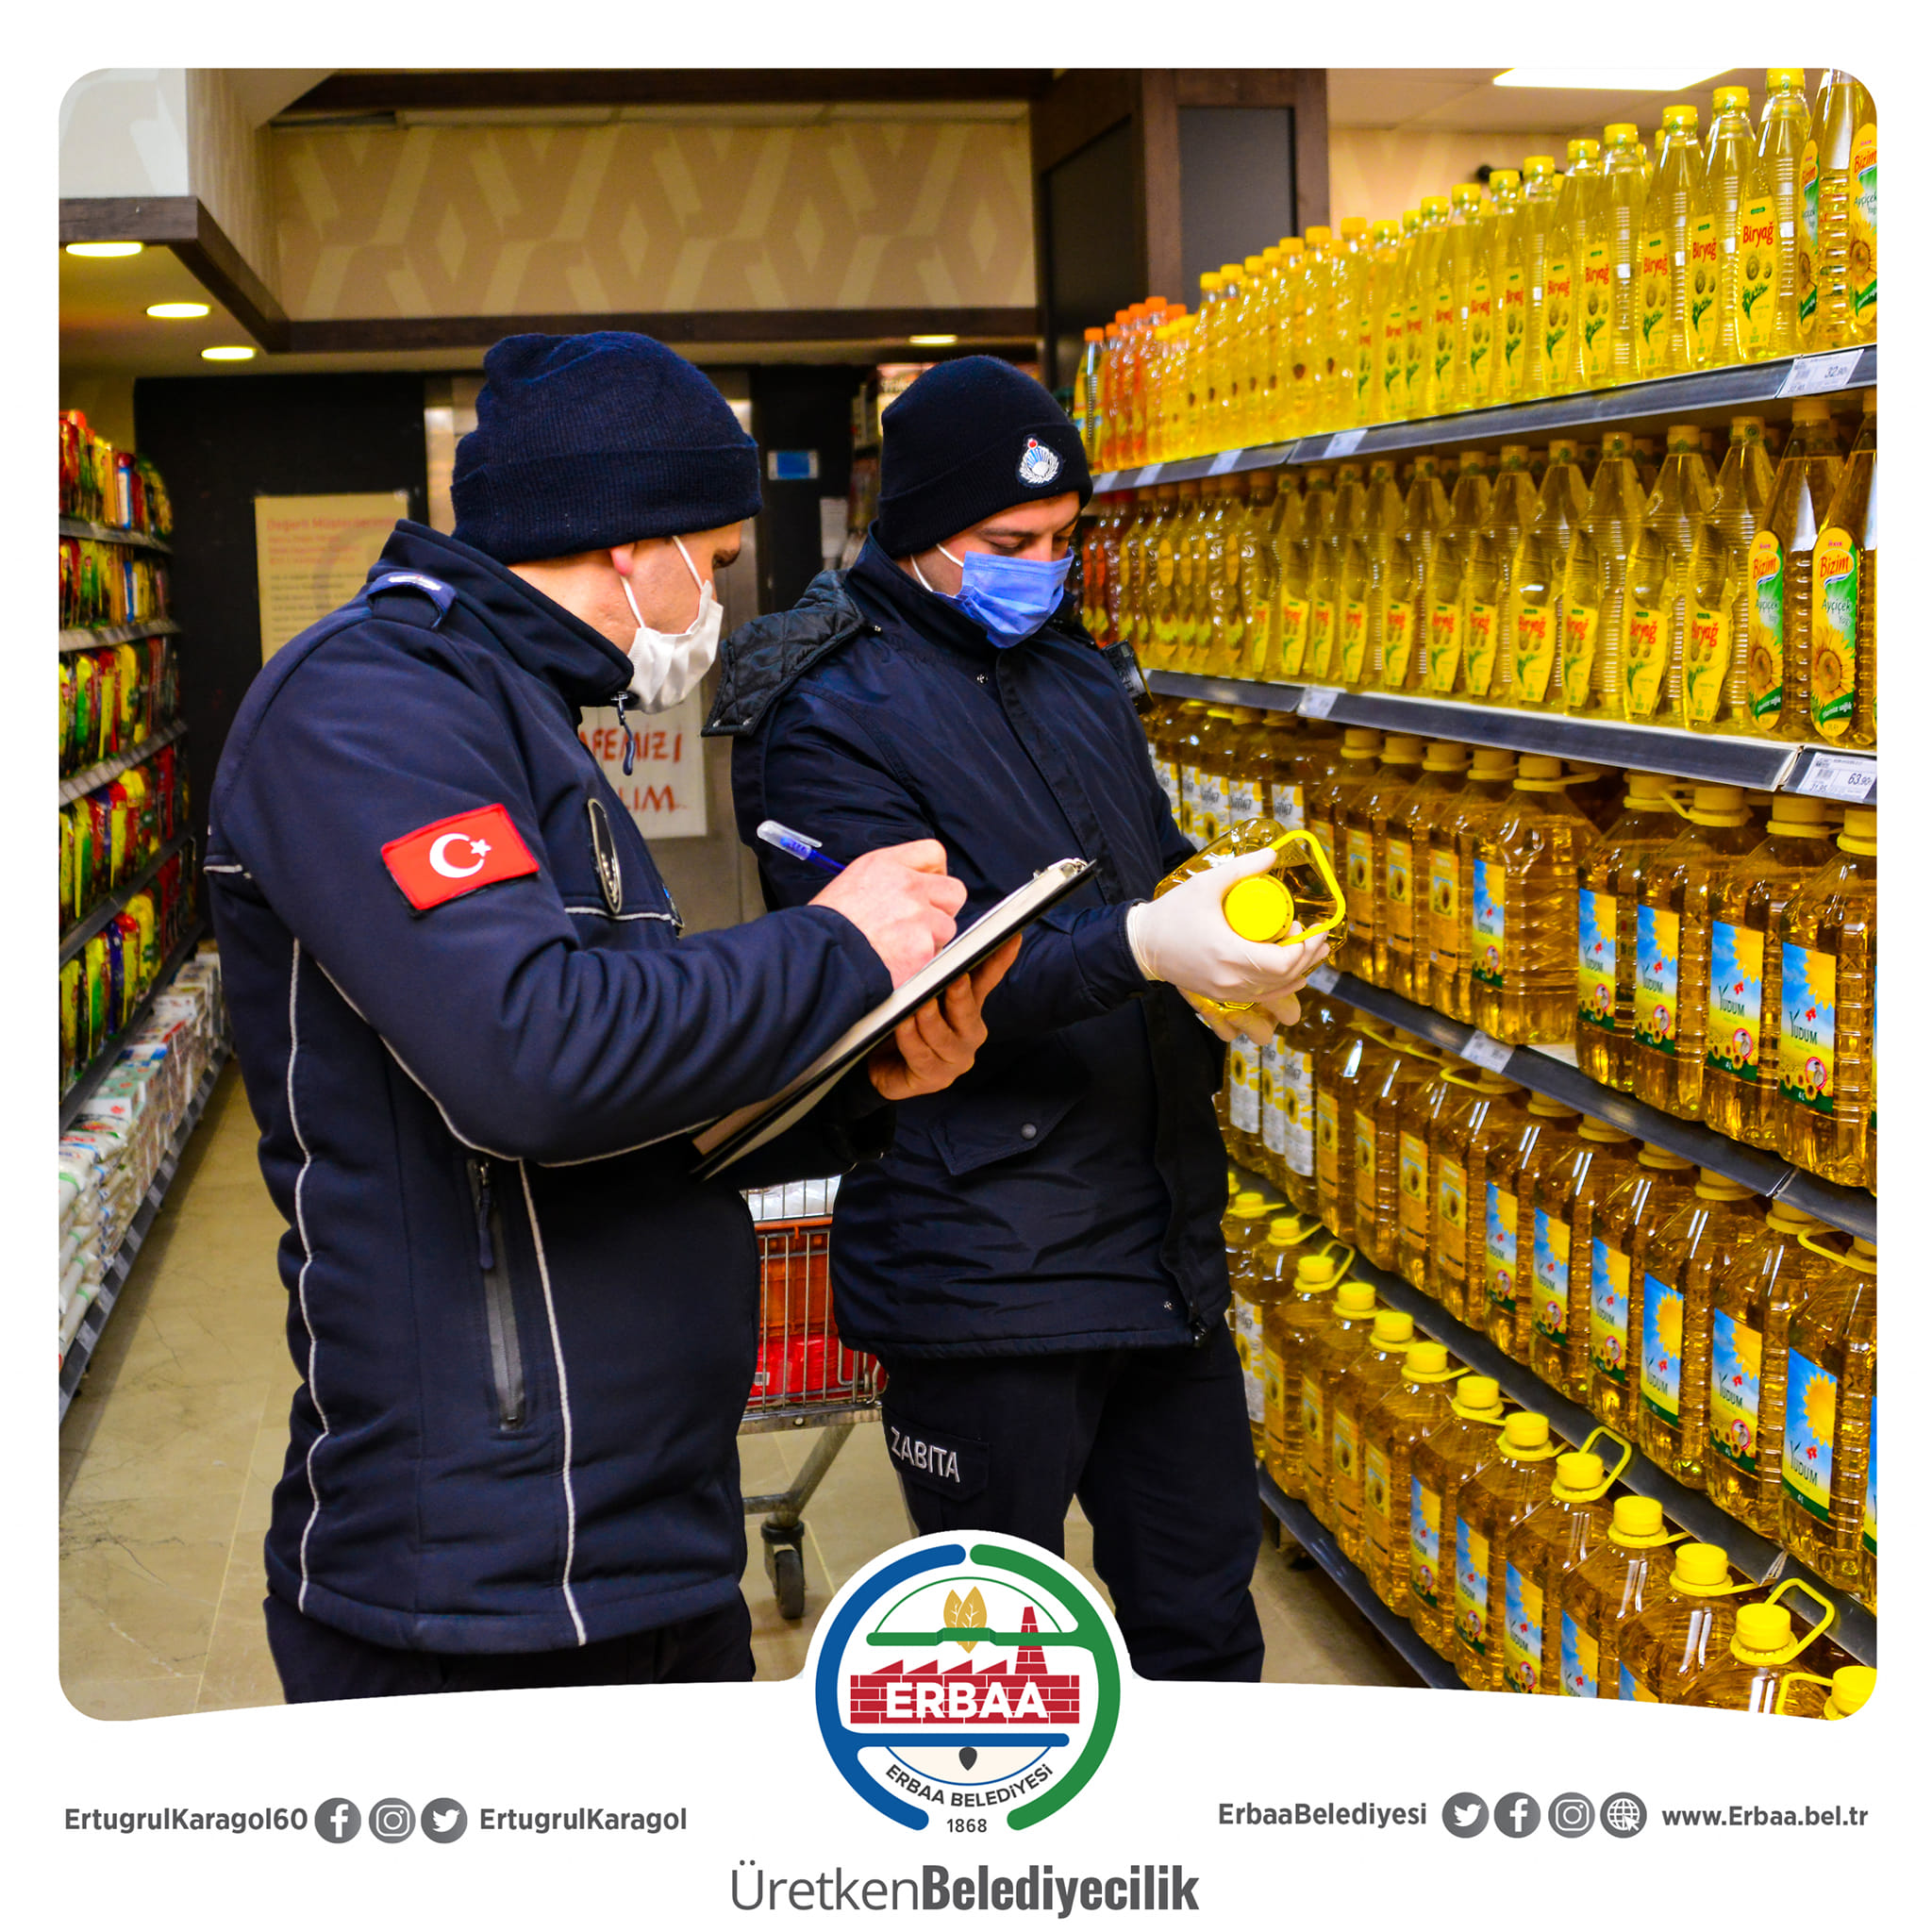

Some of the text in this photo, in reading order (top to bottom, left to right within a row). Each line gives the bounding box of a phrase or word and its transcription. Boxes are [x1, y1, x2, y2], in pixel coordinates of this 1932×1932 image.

[1742, 222, 1774, 247] Biryağ
[1753, 556, 1777, 579] Bizim
[1820, 554, 1850, 577] Bizim
[1719, 983, 1745, 1017] YUDUM
[1789, 1008, 1818, 1045] YUDUM
[891, 1426, 960, 1483] ZABITA
